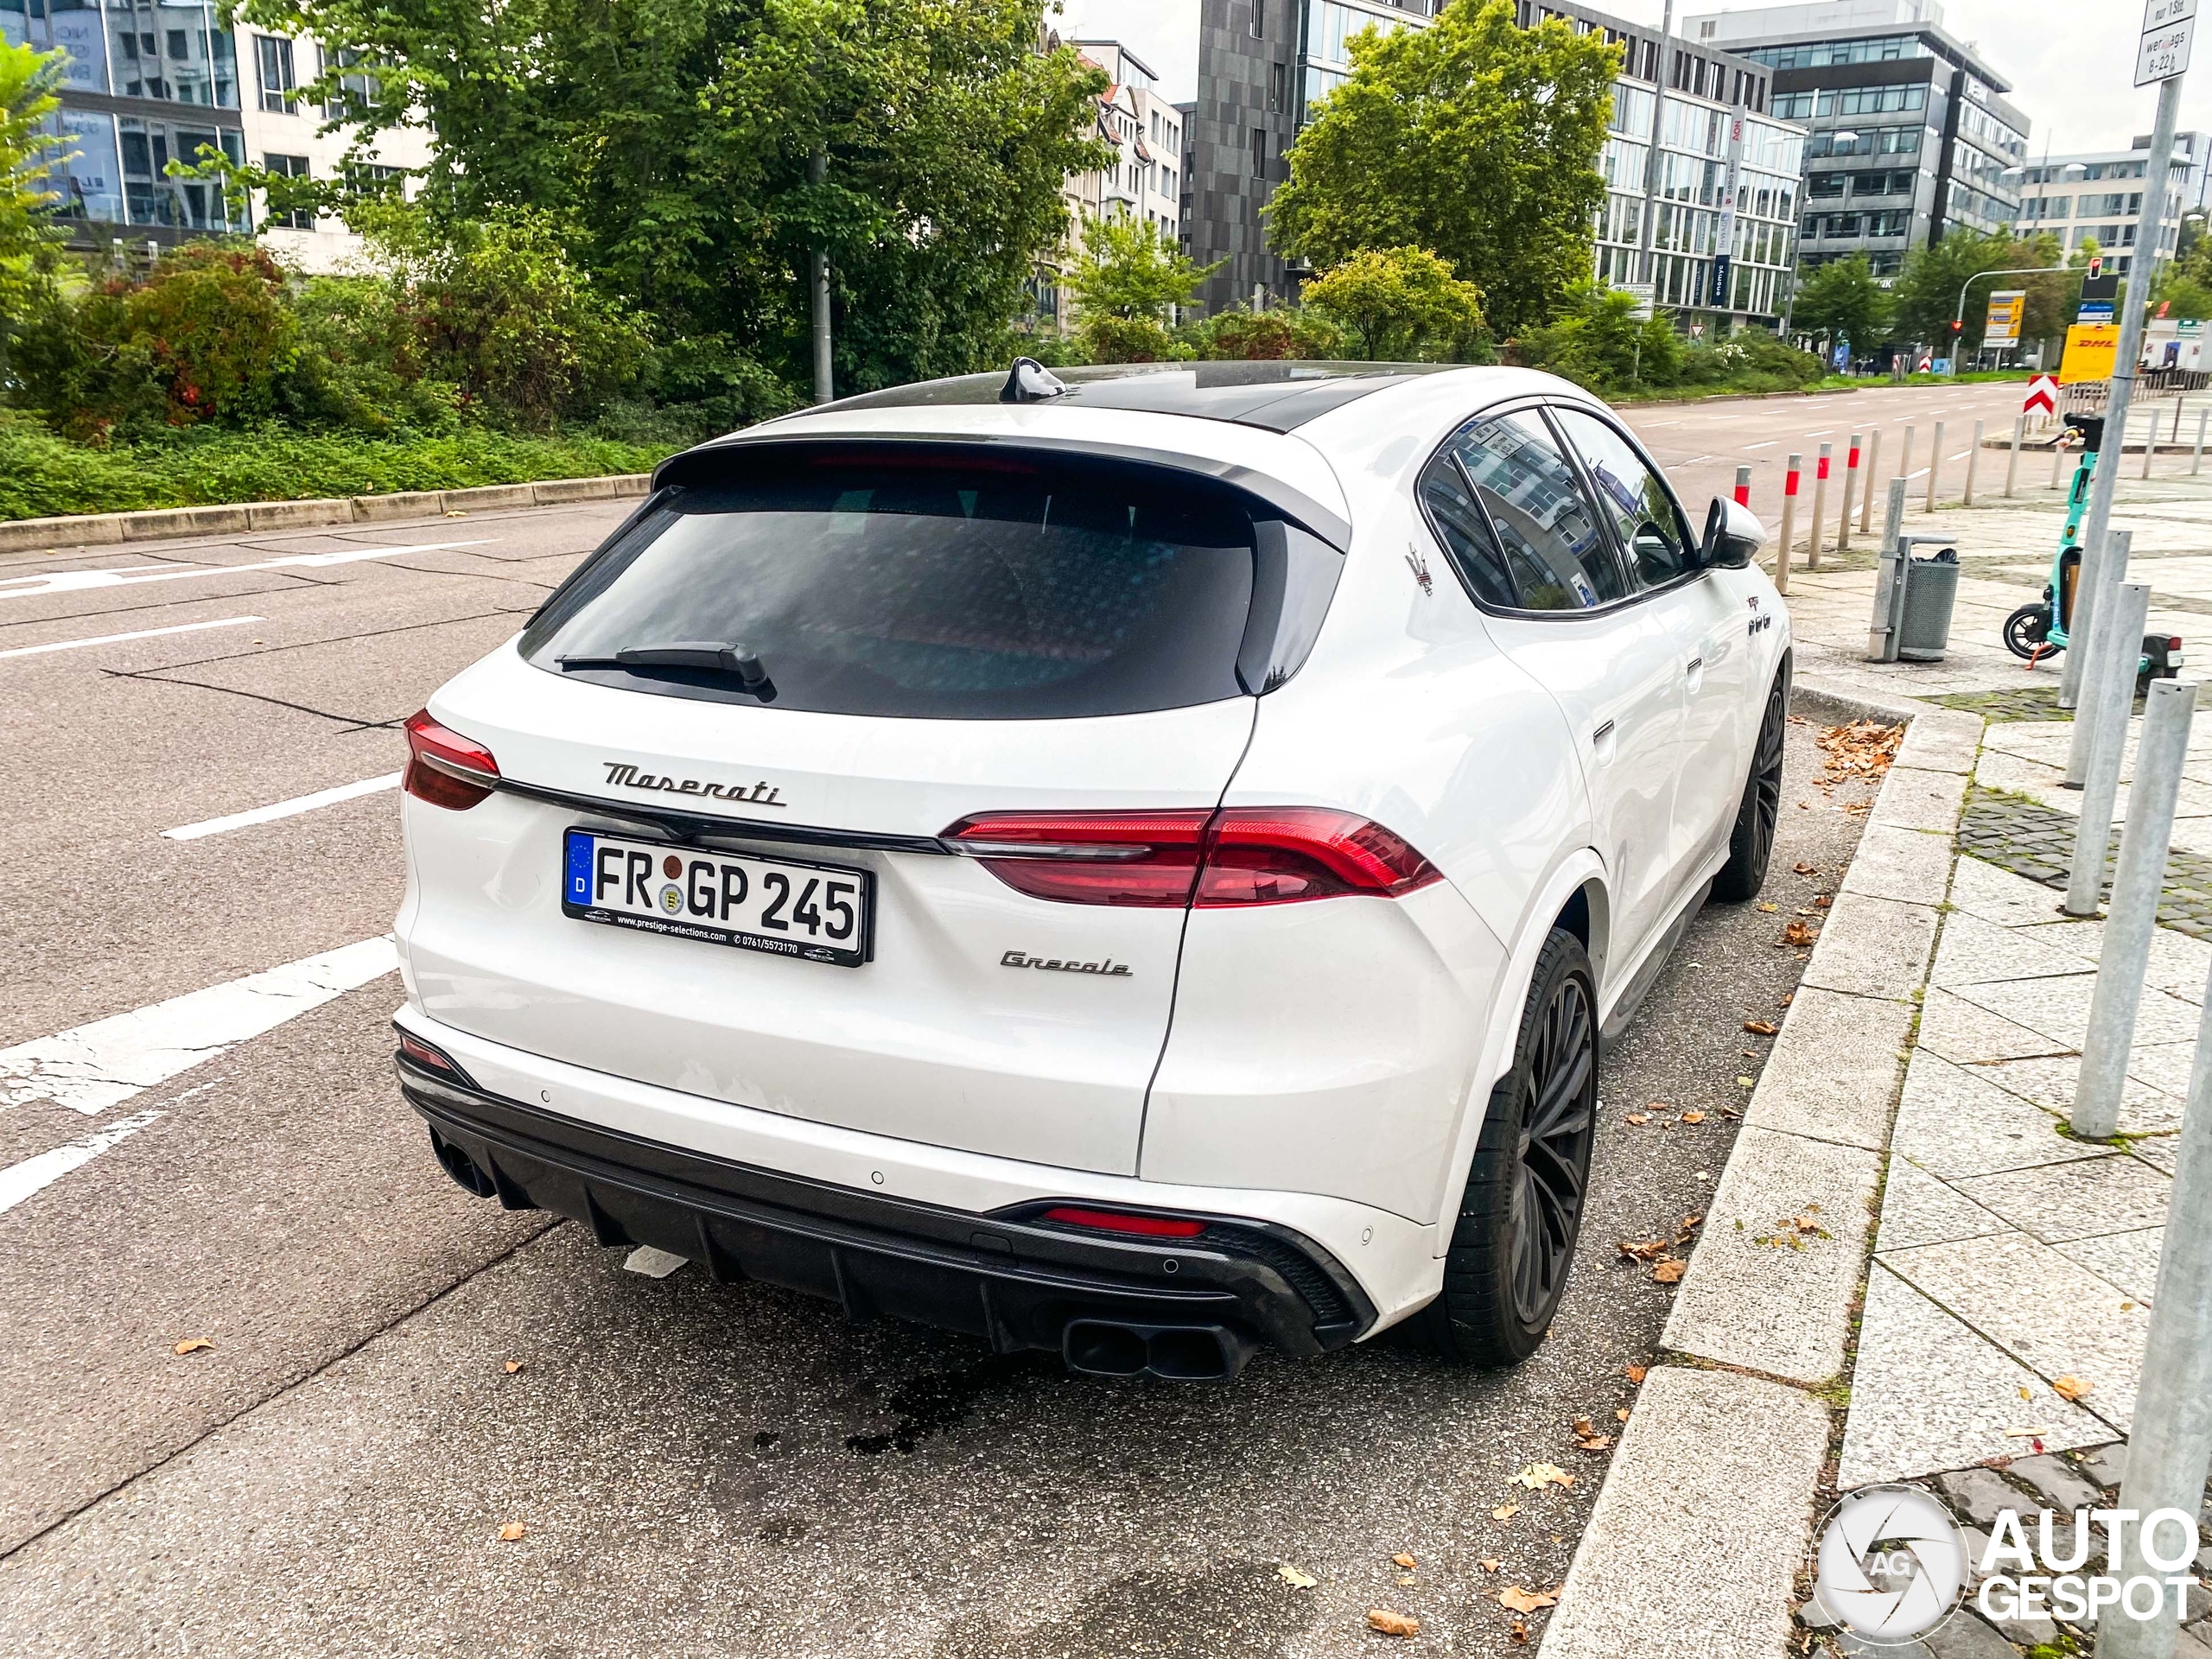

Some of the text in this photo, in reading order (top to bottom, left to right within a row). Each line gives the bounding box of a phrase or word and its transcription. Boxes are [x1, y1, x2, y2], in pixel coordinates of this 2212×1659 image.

[2155, 8, 2166, 21] nur
[2169, 3, 2172, 16] 1
[2146, 32, 2185, 54] werags
[1732, 120, 1742, 142] AON
[1716, 264, 1725, 296] enomyc
[602, 761, 787, 807] Maserati
[575, 877, 586, 893] D
[596, 847, 652, 909] FR
[687, 860, 748, 921] GP
[761, 872, 855, 939] 245
[617, 916, 798, 954] www.prestige-selections.com 0761/5573170
[1000, 950, 1133, 976] Grecale
